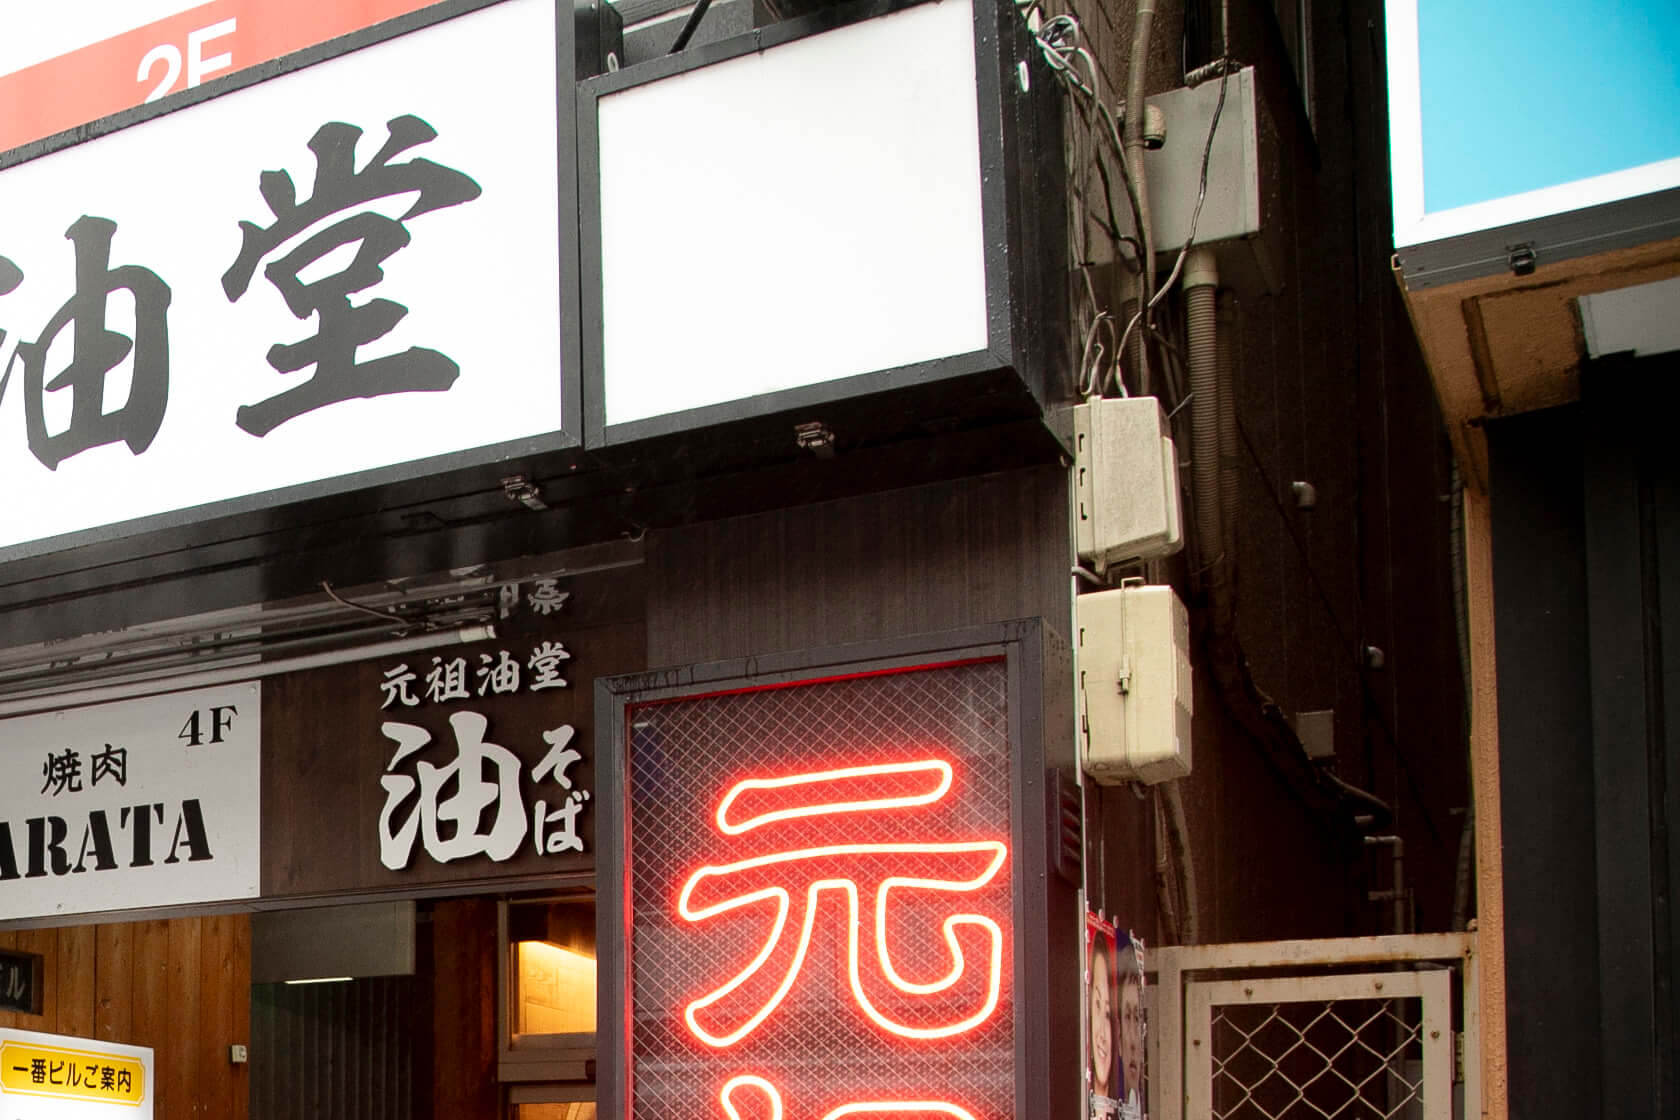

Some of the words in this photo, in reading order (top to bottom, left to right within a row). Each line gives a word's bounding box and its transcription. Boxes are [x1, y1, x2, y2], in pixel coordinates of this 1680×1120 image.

[380, 641, 570, 710] 元祖油堂
[178, 705, 238, 747] 4F
[41, 743, 128, 796] 焼肉
[12, 1058, 132, 1093] 一番ビルご案内
